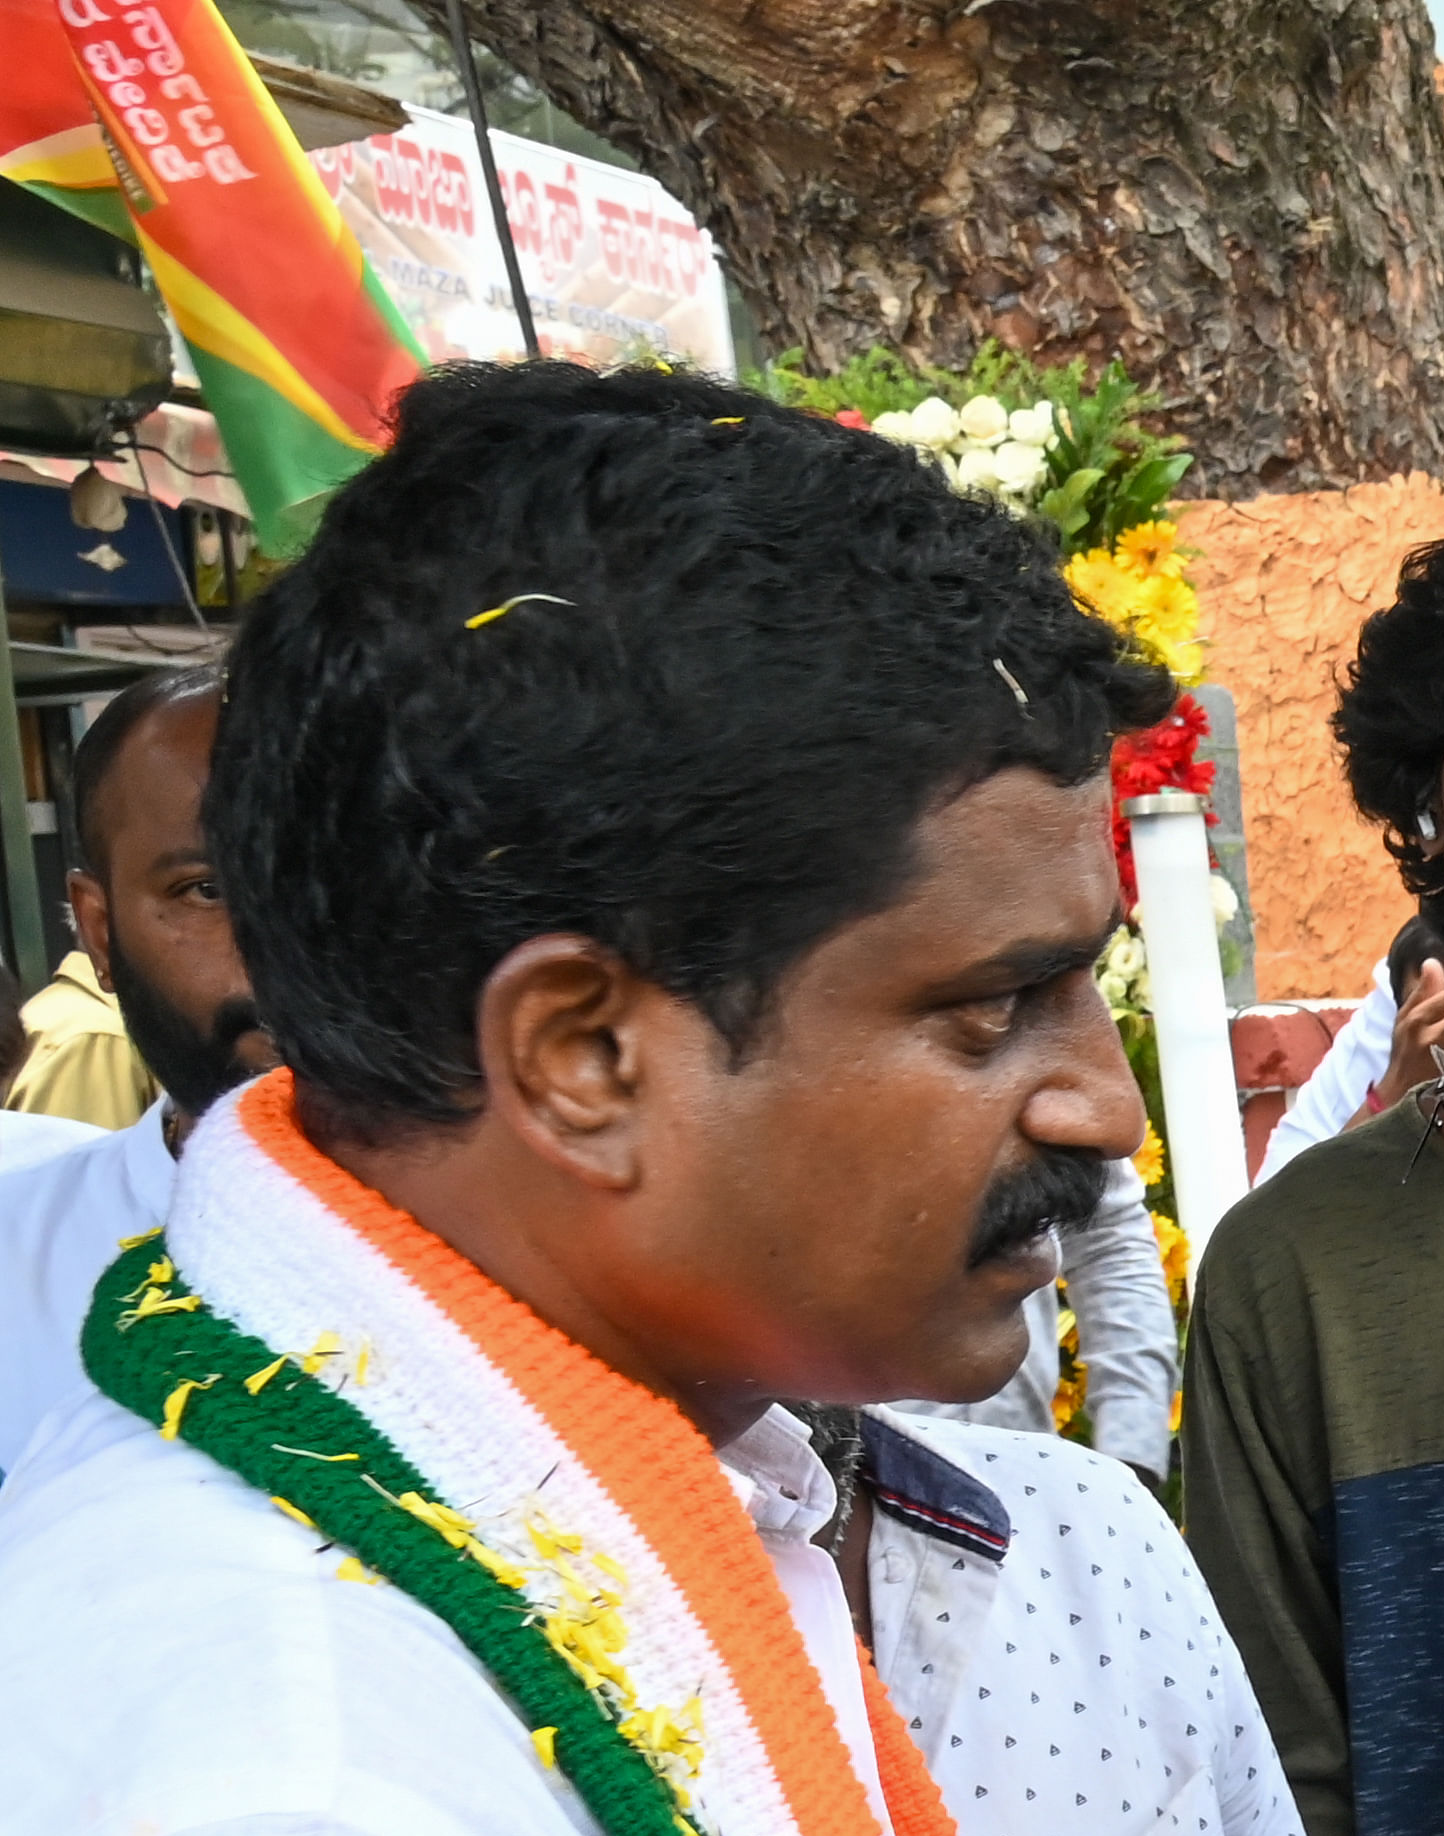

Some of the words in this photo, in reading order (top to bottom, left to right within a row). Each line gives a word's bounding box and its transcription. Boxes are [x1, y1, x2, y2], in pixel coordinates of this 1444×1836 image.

[113, 0, 259, 185] ರ್ನಾಟಕ
[390, 259, 470, 300] MAZA
[484, 283, 560, 322] JUCE
